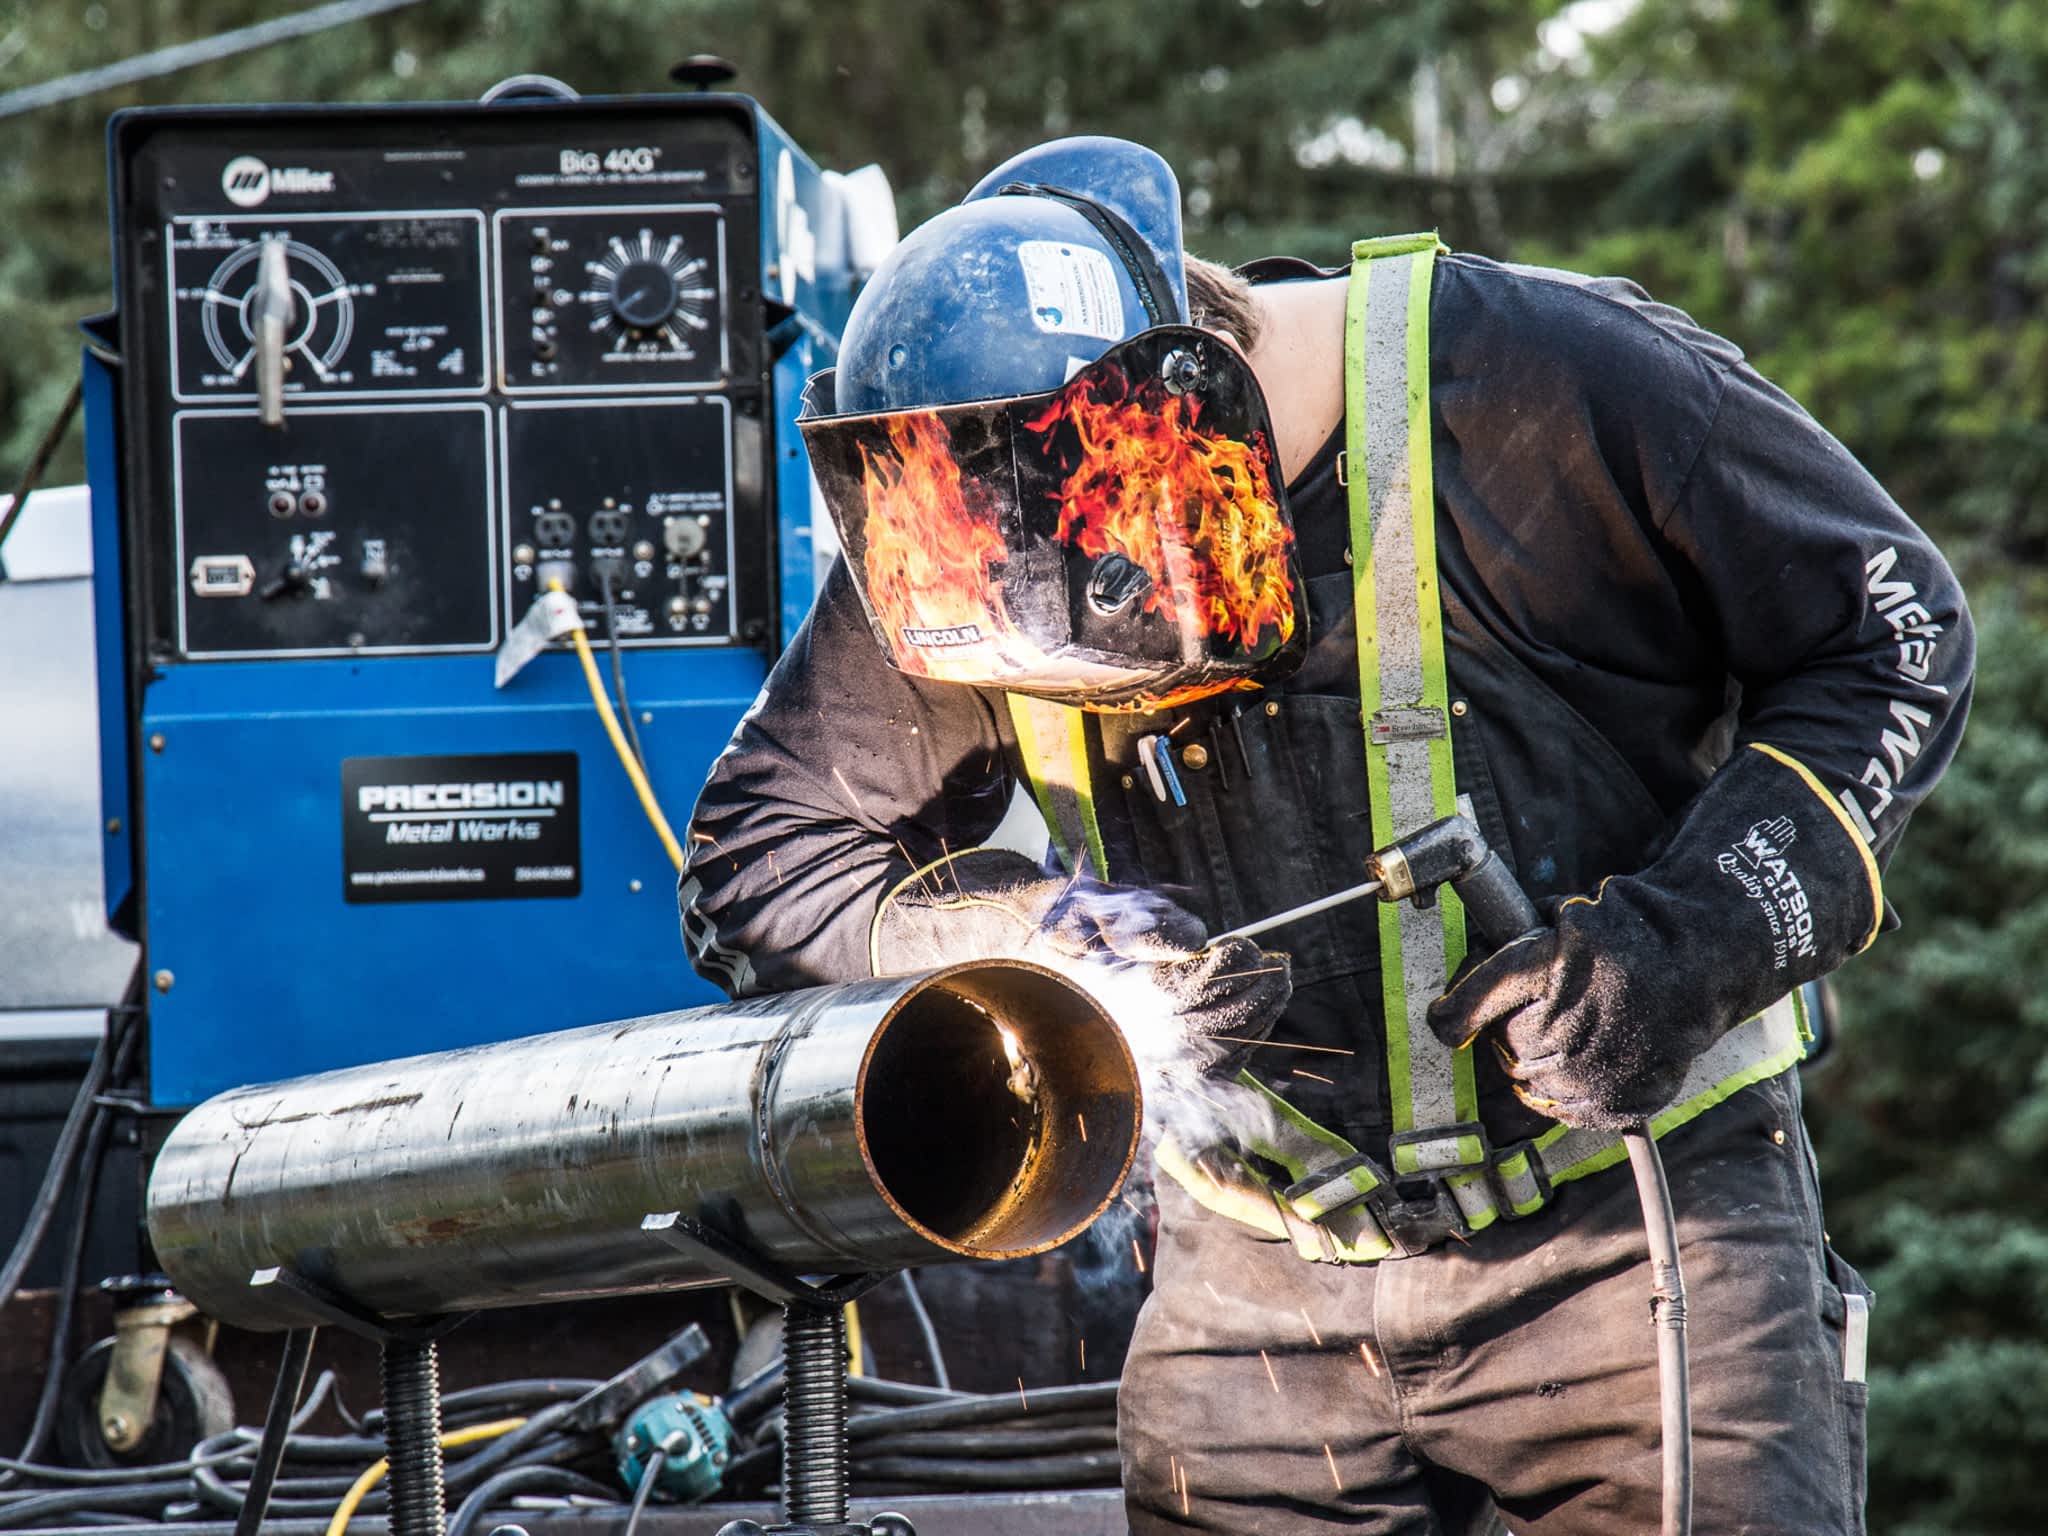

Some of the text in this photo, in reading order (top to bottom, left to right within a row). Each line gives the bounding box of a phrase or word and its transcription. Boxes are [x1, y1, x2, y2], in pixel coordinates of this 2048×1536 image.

[906, 626, 978, 645] LINCOLN
[359, 780, 564, 811] PRECISION
[386, 819, 541, 844] Metal Works
[1715, 853, 1787, 970] Quality since 1918
[1745, 829, 1814, 957] WATSON
[1764, 875, 1798, 949] GLOVES
